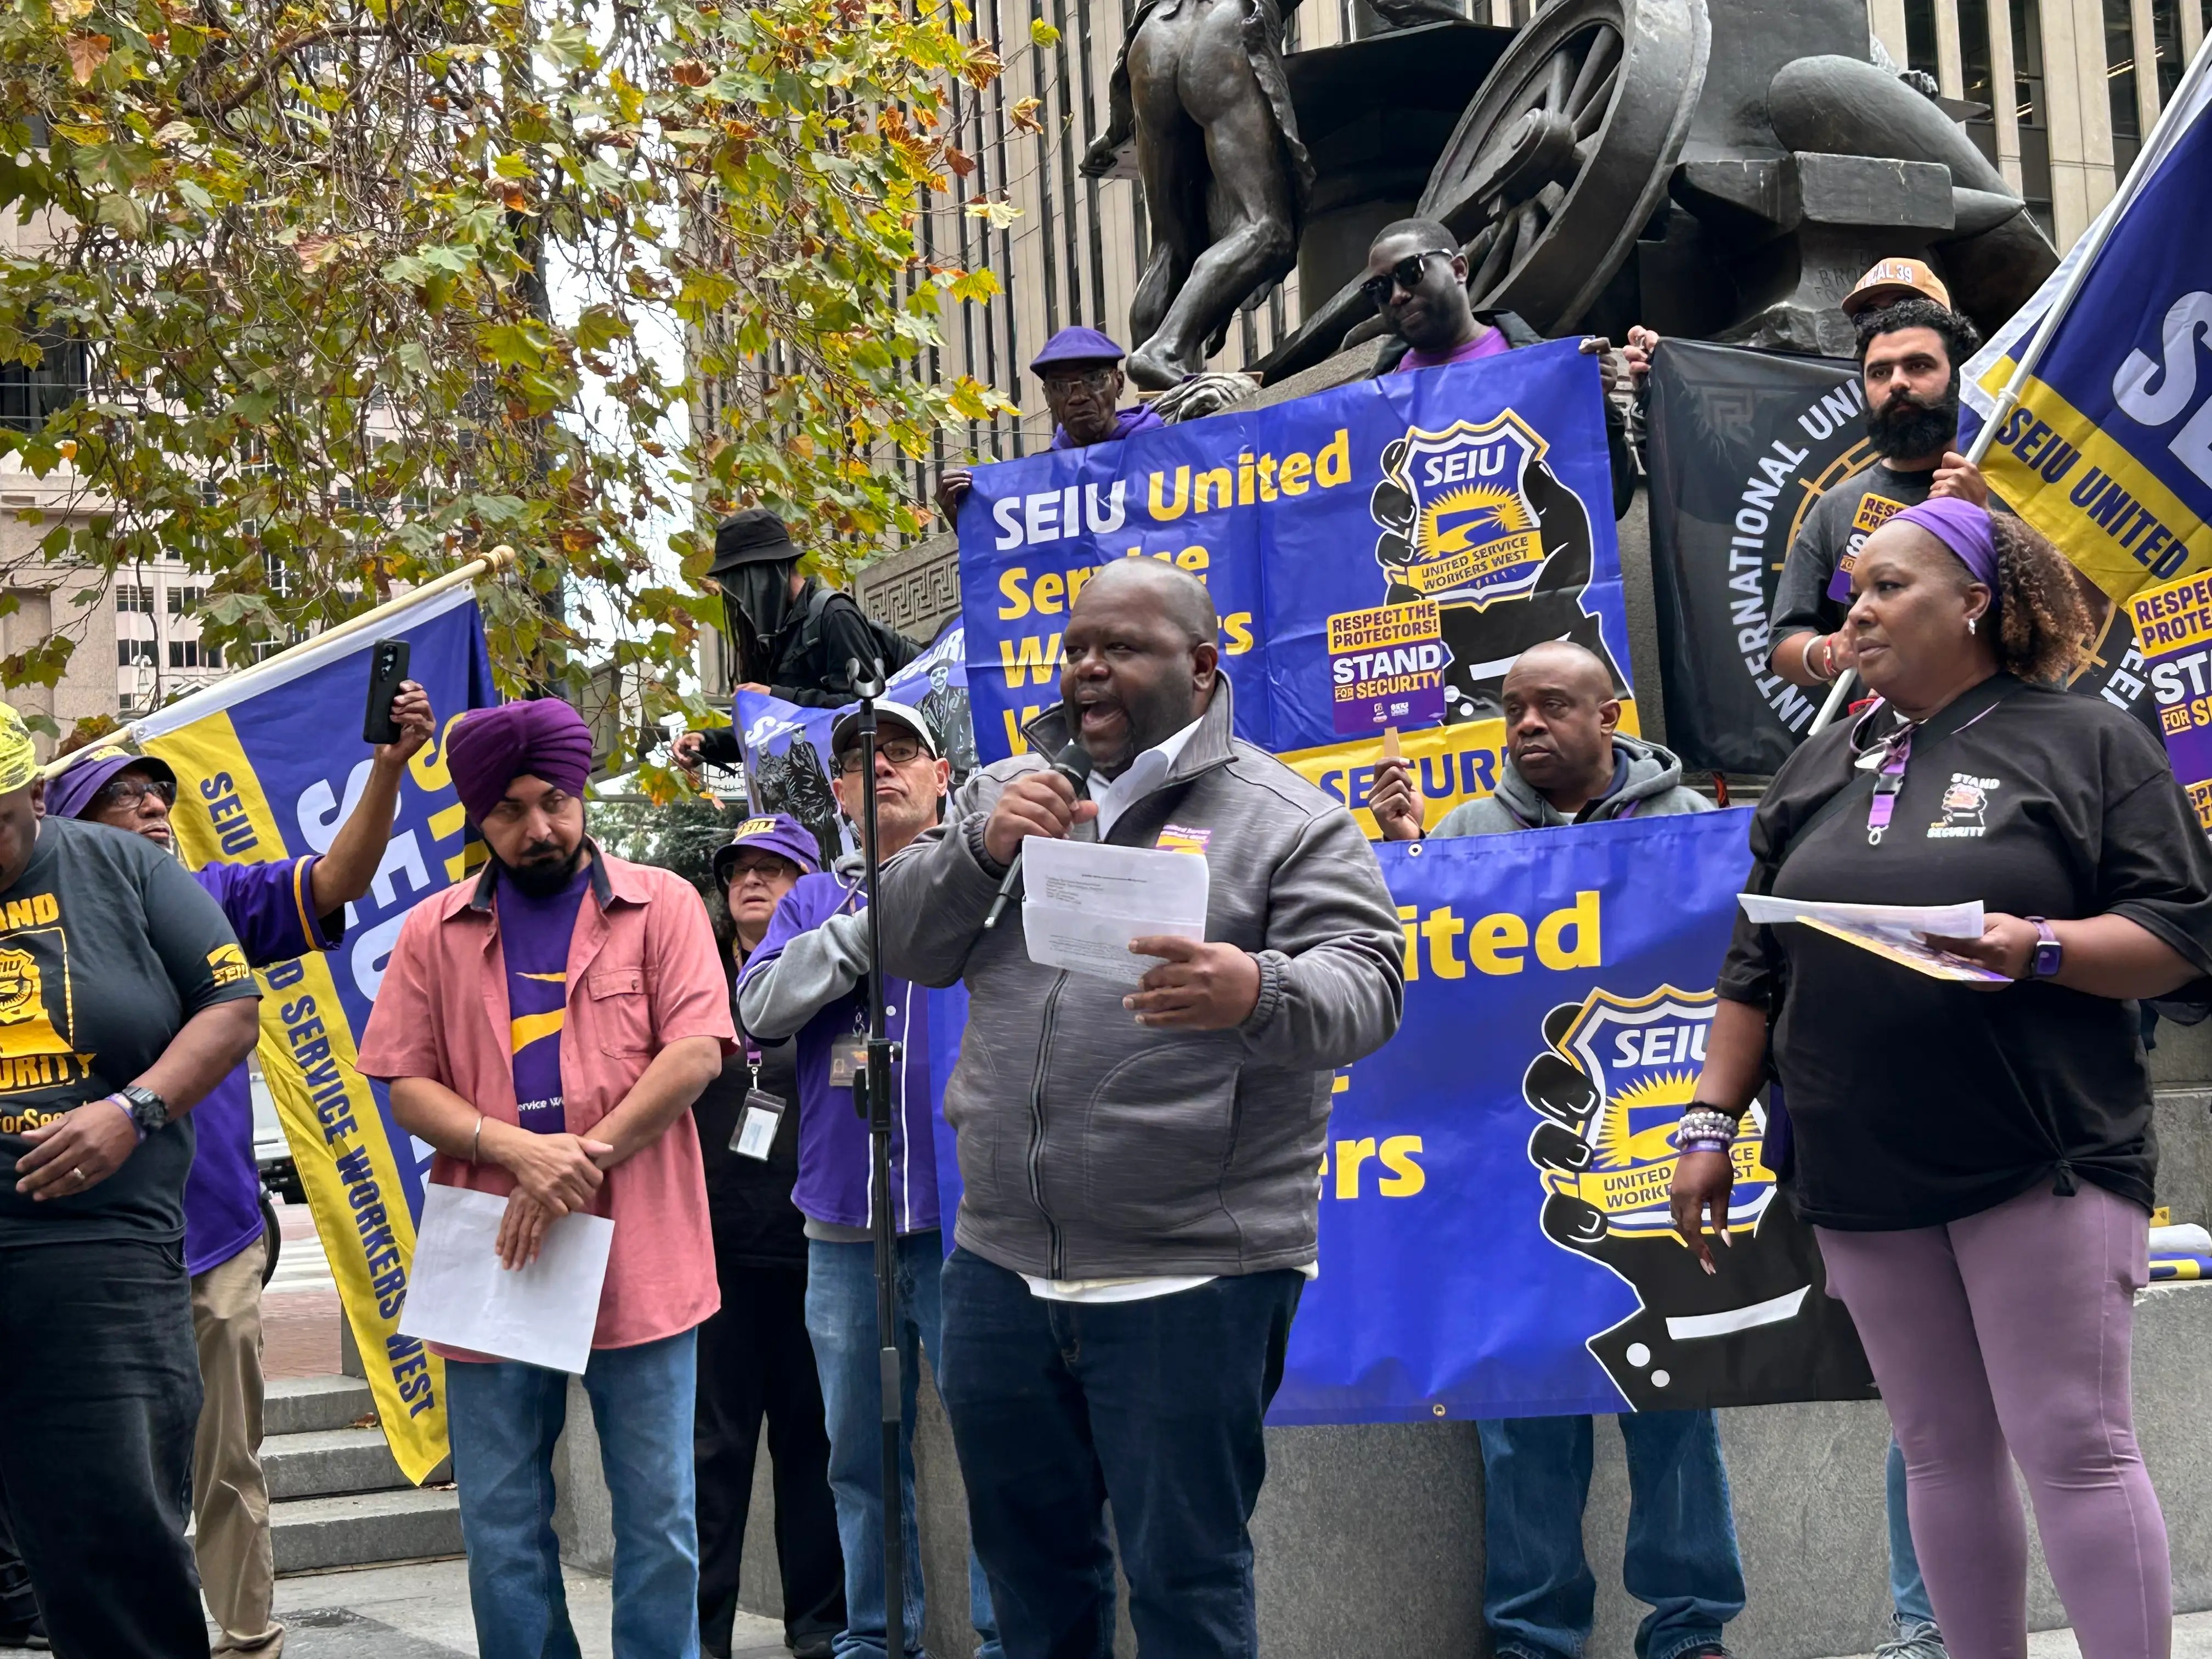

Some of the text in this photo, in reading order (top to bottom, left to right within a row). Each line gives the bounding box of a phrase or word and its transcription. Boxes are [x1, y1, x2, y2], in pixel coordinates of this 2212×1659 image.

[1896, 264, 1912, 284] 39
[1798, 378, 1864, 440] UNI
[1424, 444, 1506, 487] SEIU
[994, 428, 1351, 550] SEIU United
[1995, 407, 2189, 580] SEIU UNITED
[1422, 536, 1528, 578] UNITED SERVICE
[1423, 549, 1528, 590] WORKERS WEST
[1729, 440, 1815, 732] INTERNATIONAL
[2135, 577, 2212, 624] RESPE
[1333, 603, 1436, 633] RESPECT THE
[1334, 619, 1437, 648] PROTECTORS!
[1333, 644, 1441, 684] STAND
[1335, 670, 1442, 700] FOR SECURITY
[2161, 709, 2191, 731] FOR
[1951, 773, 2000, 789] STAND
[200, 772, 258, 855] SEIU
[1396, 890, 1601, 981] ited
[213, 964, 250, 987] SEIU
[517, 1099, 547, 1111] ervice
[1604, 1166, 1671, 1191] UNITED
[1606, 1184, 1671, 1208] WORKE
[281, 995, 358, 1146] SERVICE
[336, 1144, 407, 1319] WORKERS
[386, 1333, 435, 1419] WEST
